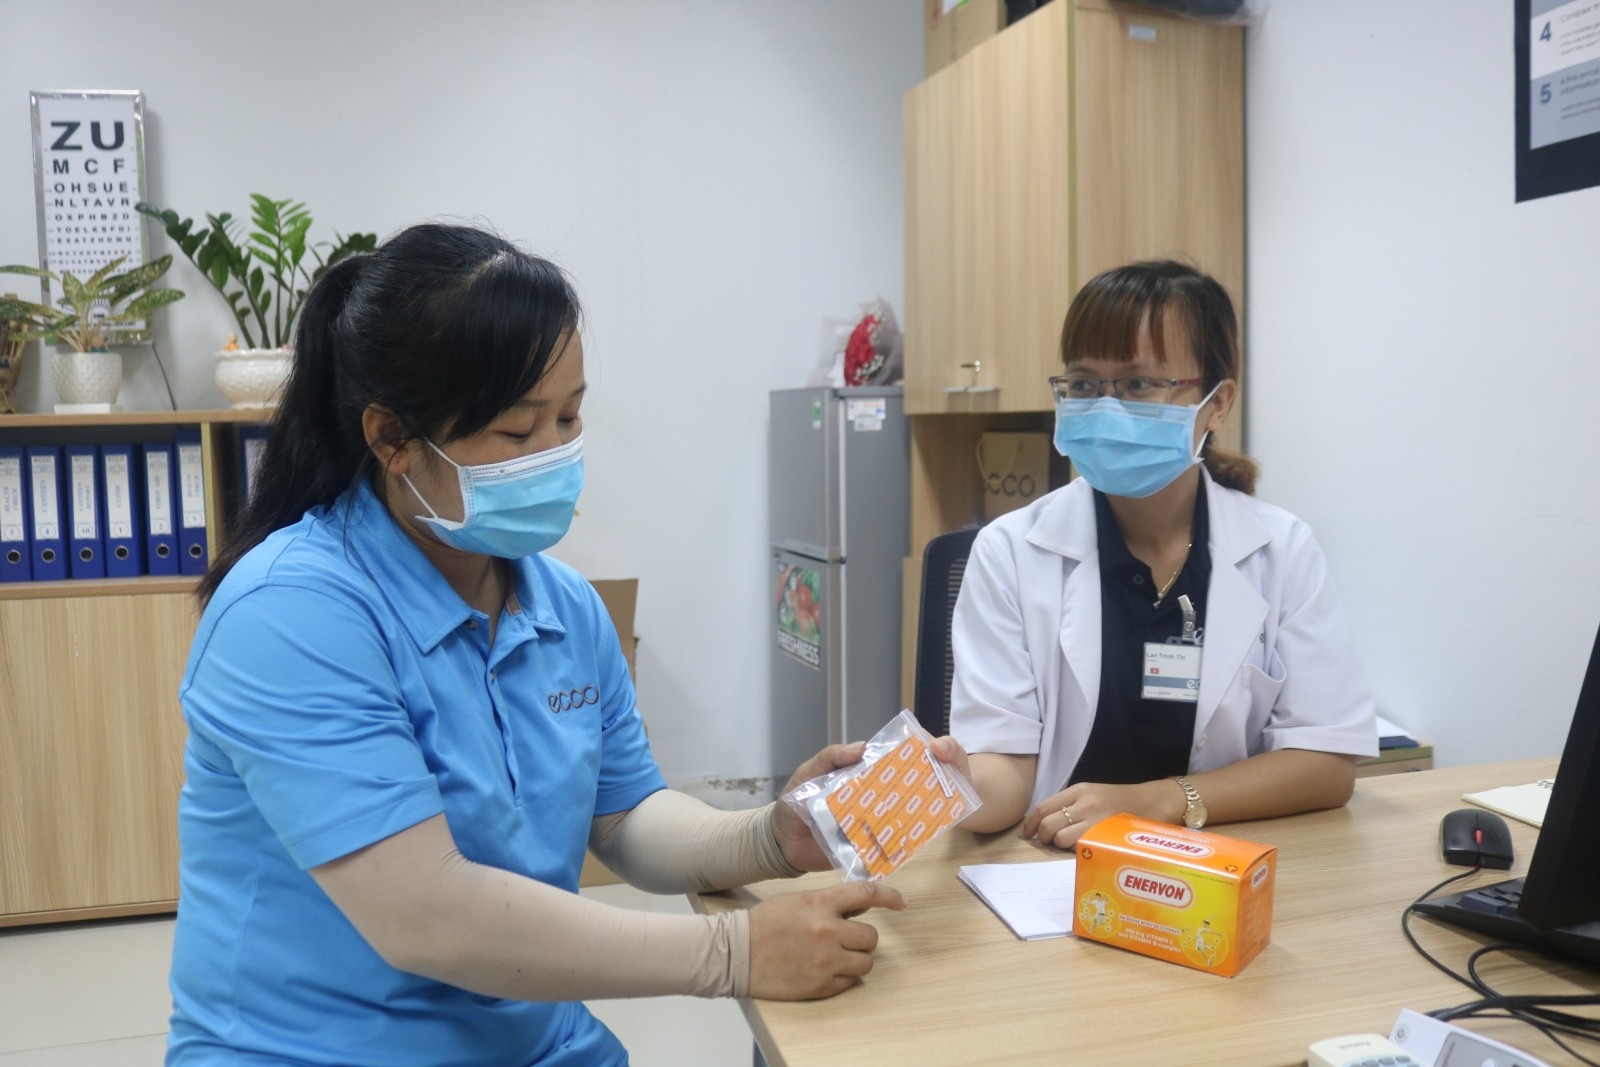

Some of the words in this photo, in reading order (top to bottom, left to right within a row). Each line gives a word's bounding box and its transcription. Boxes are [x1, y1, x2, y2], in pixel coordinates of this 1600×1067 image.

[1540, 21, 1552, 41] 4
[1540, 83, 1552, 104] 5
[1136, 835, 1202, 854] ENERVON
[1124, 875, 1185, 901] ENERVON
[1145, 933, 1168, 944] VITAMIN
[1153, 923, 1180, 936] RESISTANCE
